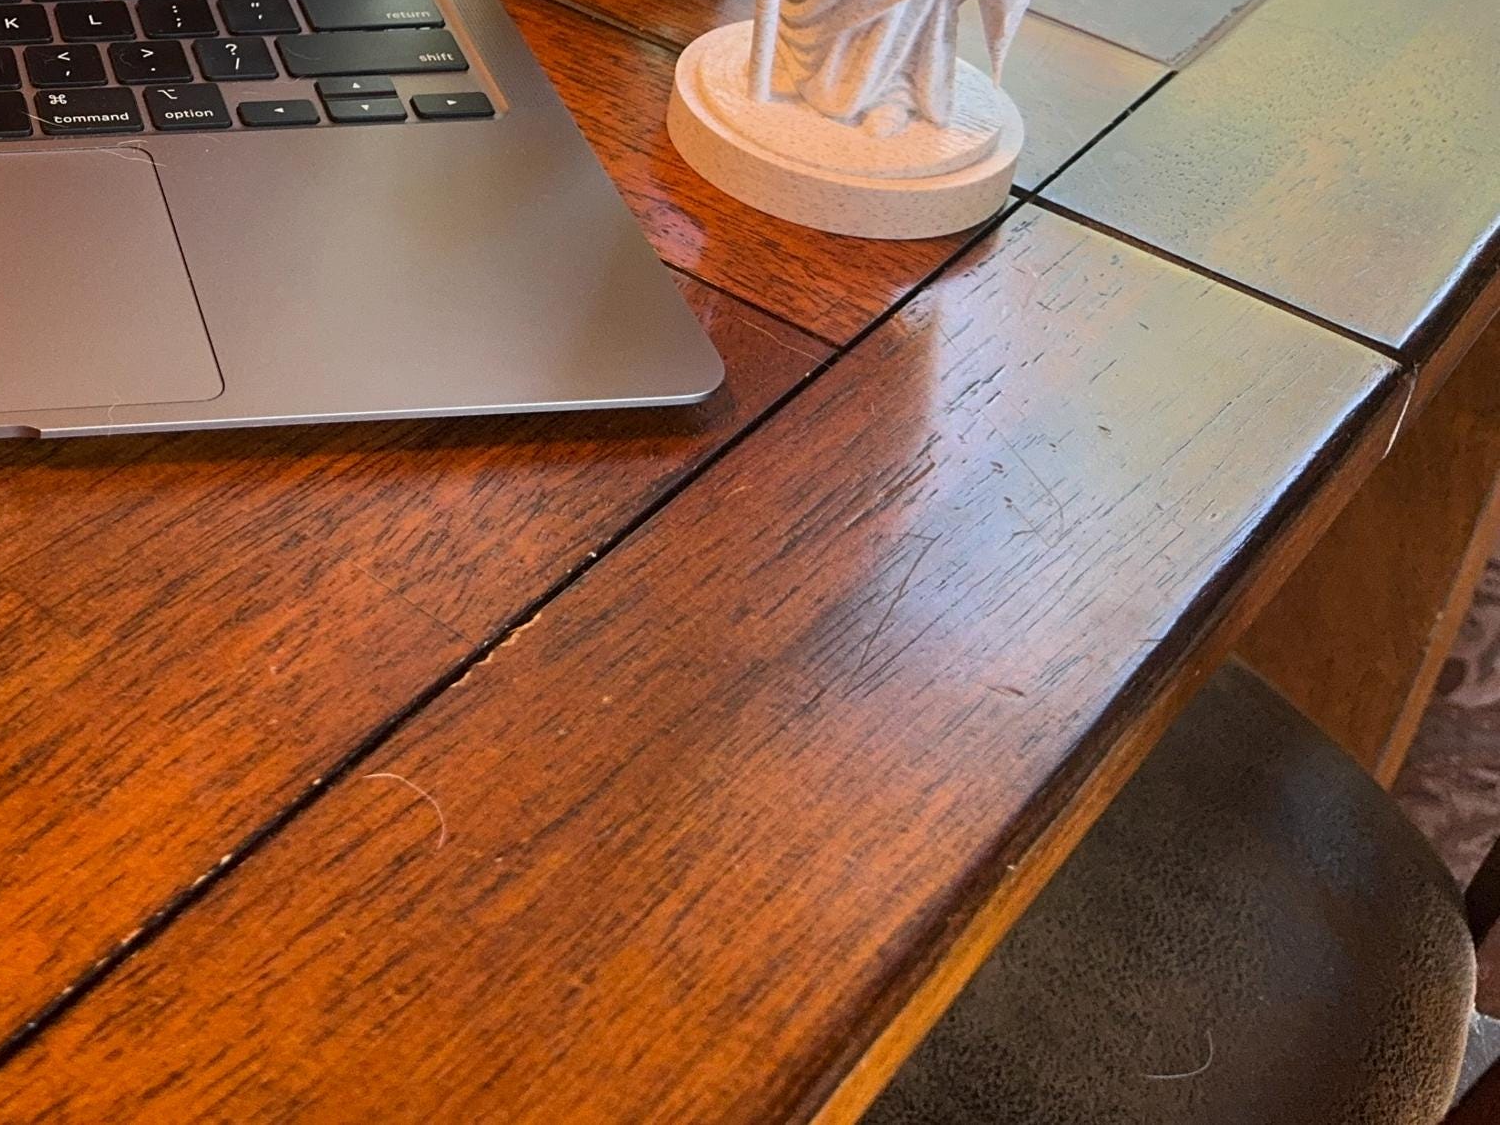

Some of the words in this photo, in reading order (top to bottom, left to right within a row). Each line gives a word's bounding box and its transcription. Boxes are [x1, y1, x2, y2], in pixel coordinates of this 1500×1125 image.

[88, 14, 102, 25] L
[386, 11, 430, 19] return
[4, 17, 20, 29] K
[418, 52, 453, 62] shift
[54, 112, 130, 124] command
[164, 109, 214, 120] option
